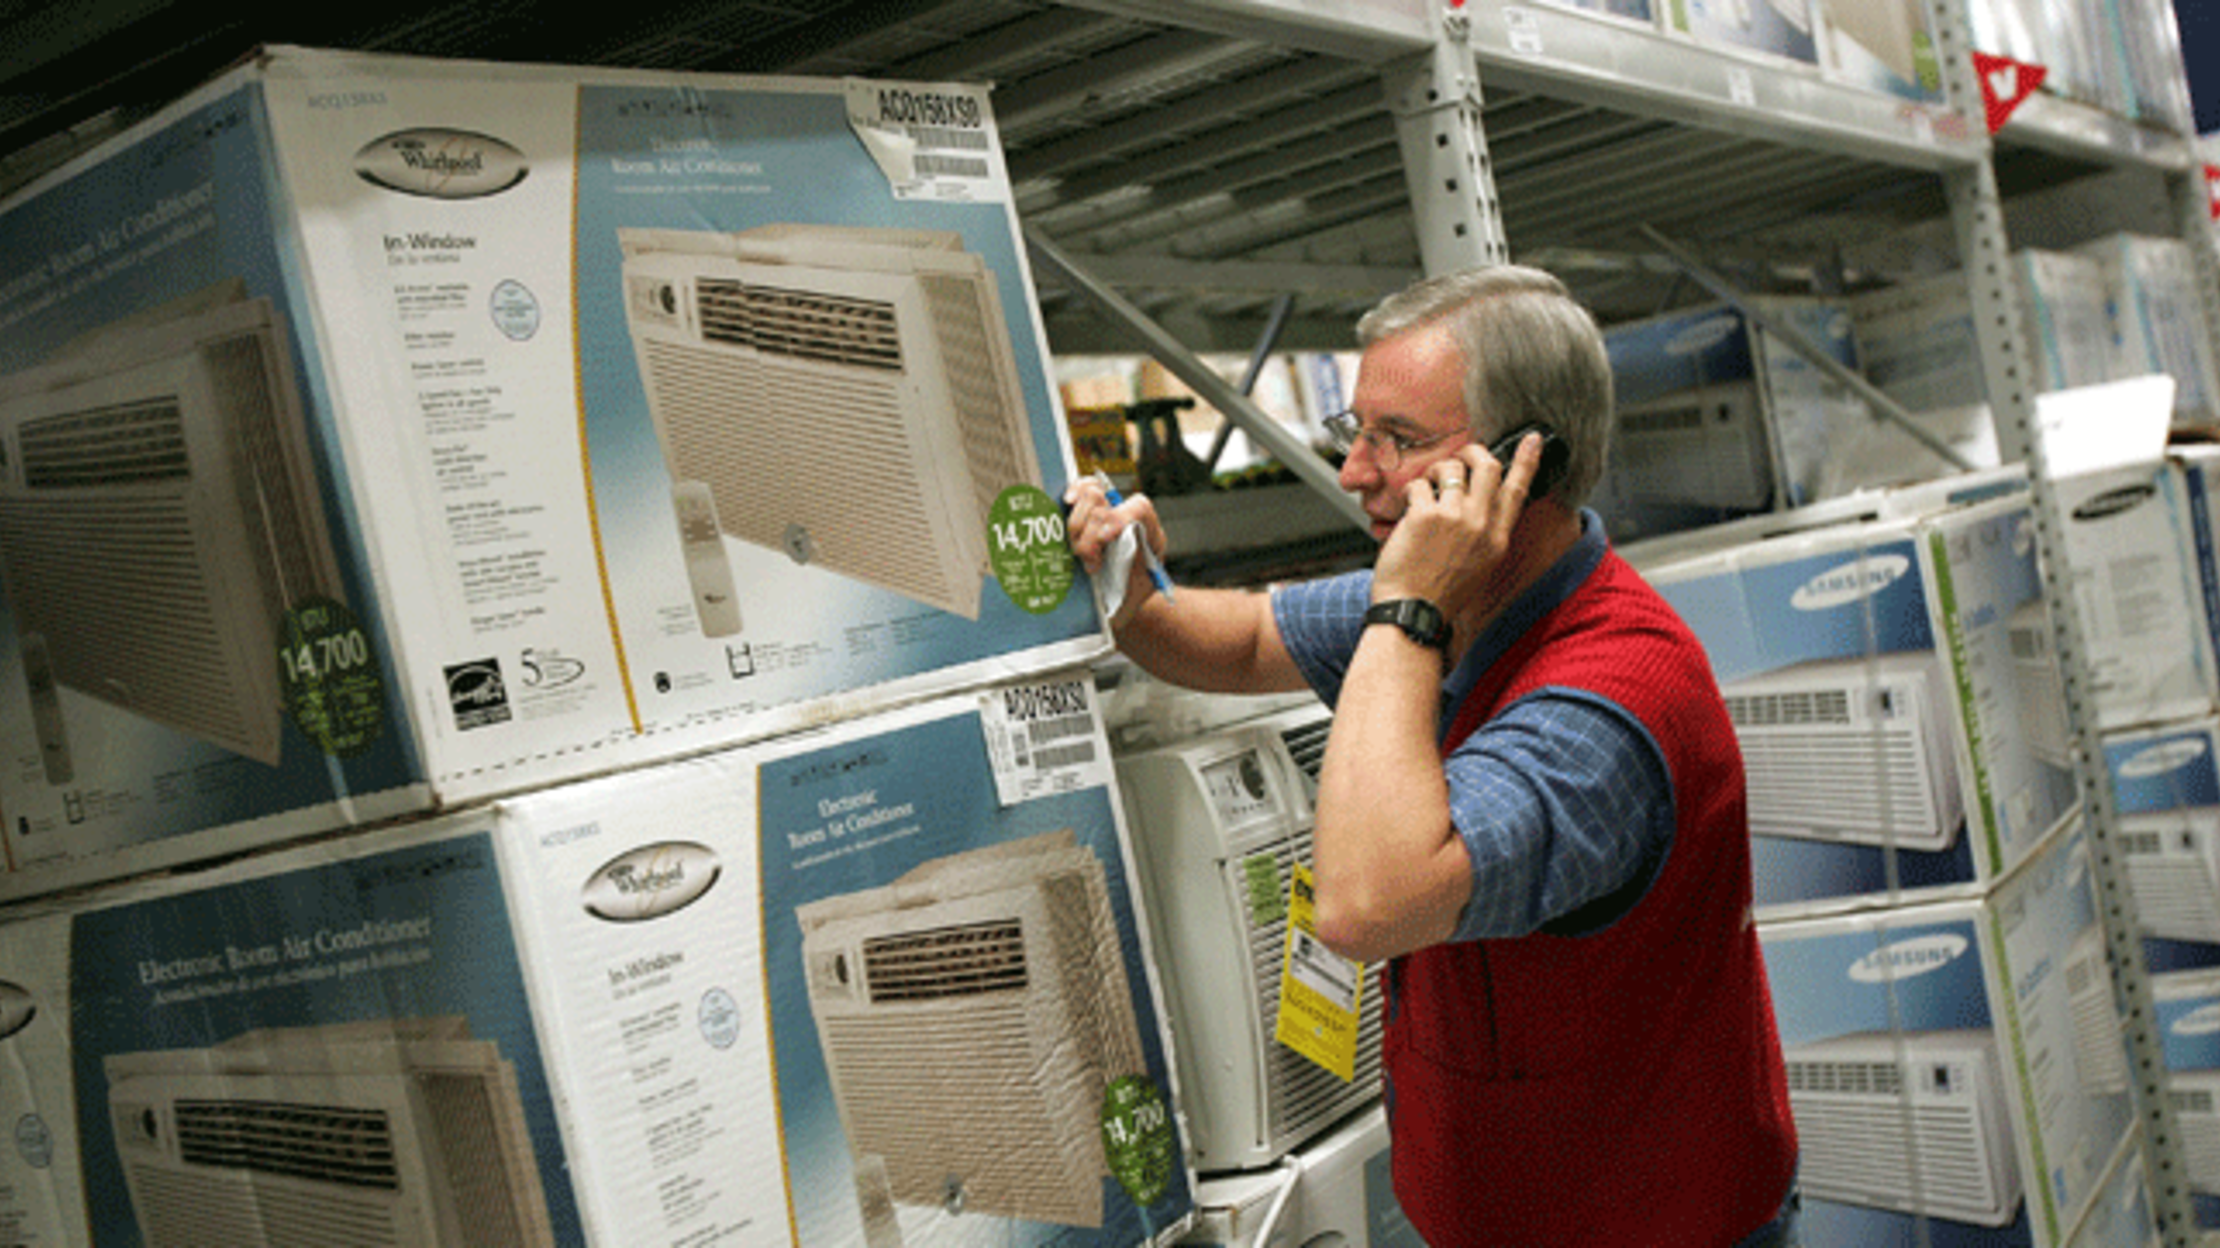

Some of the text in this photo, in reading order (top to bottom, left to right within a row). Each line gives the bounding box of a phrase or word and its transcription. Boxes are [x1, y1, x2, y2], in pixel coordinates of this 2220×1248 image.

[401, 150, 483, 176] Whirlpool
[992, 513, 1065, 553] 14,700
[1805, 567, 1895, 597] SAMSNG
[280, 628, 368, 683] 14,700
[314, 917, 431, 953] Conditioner
